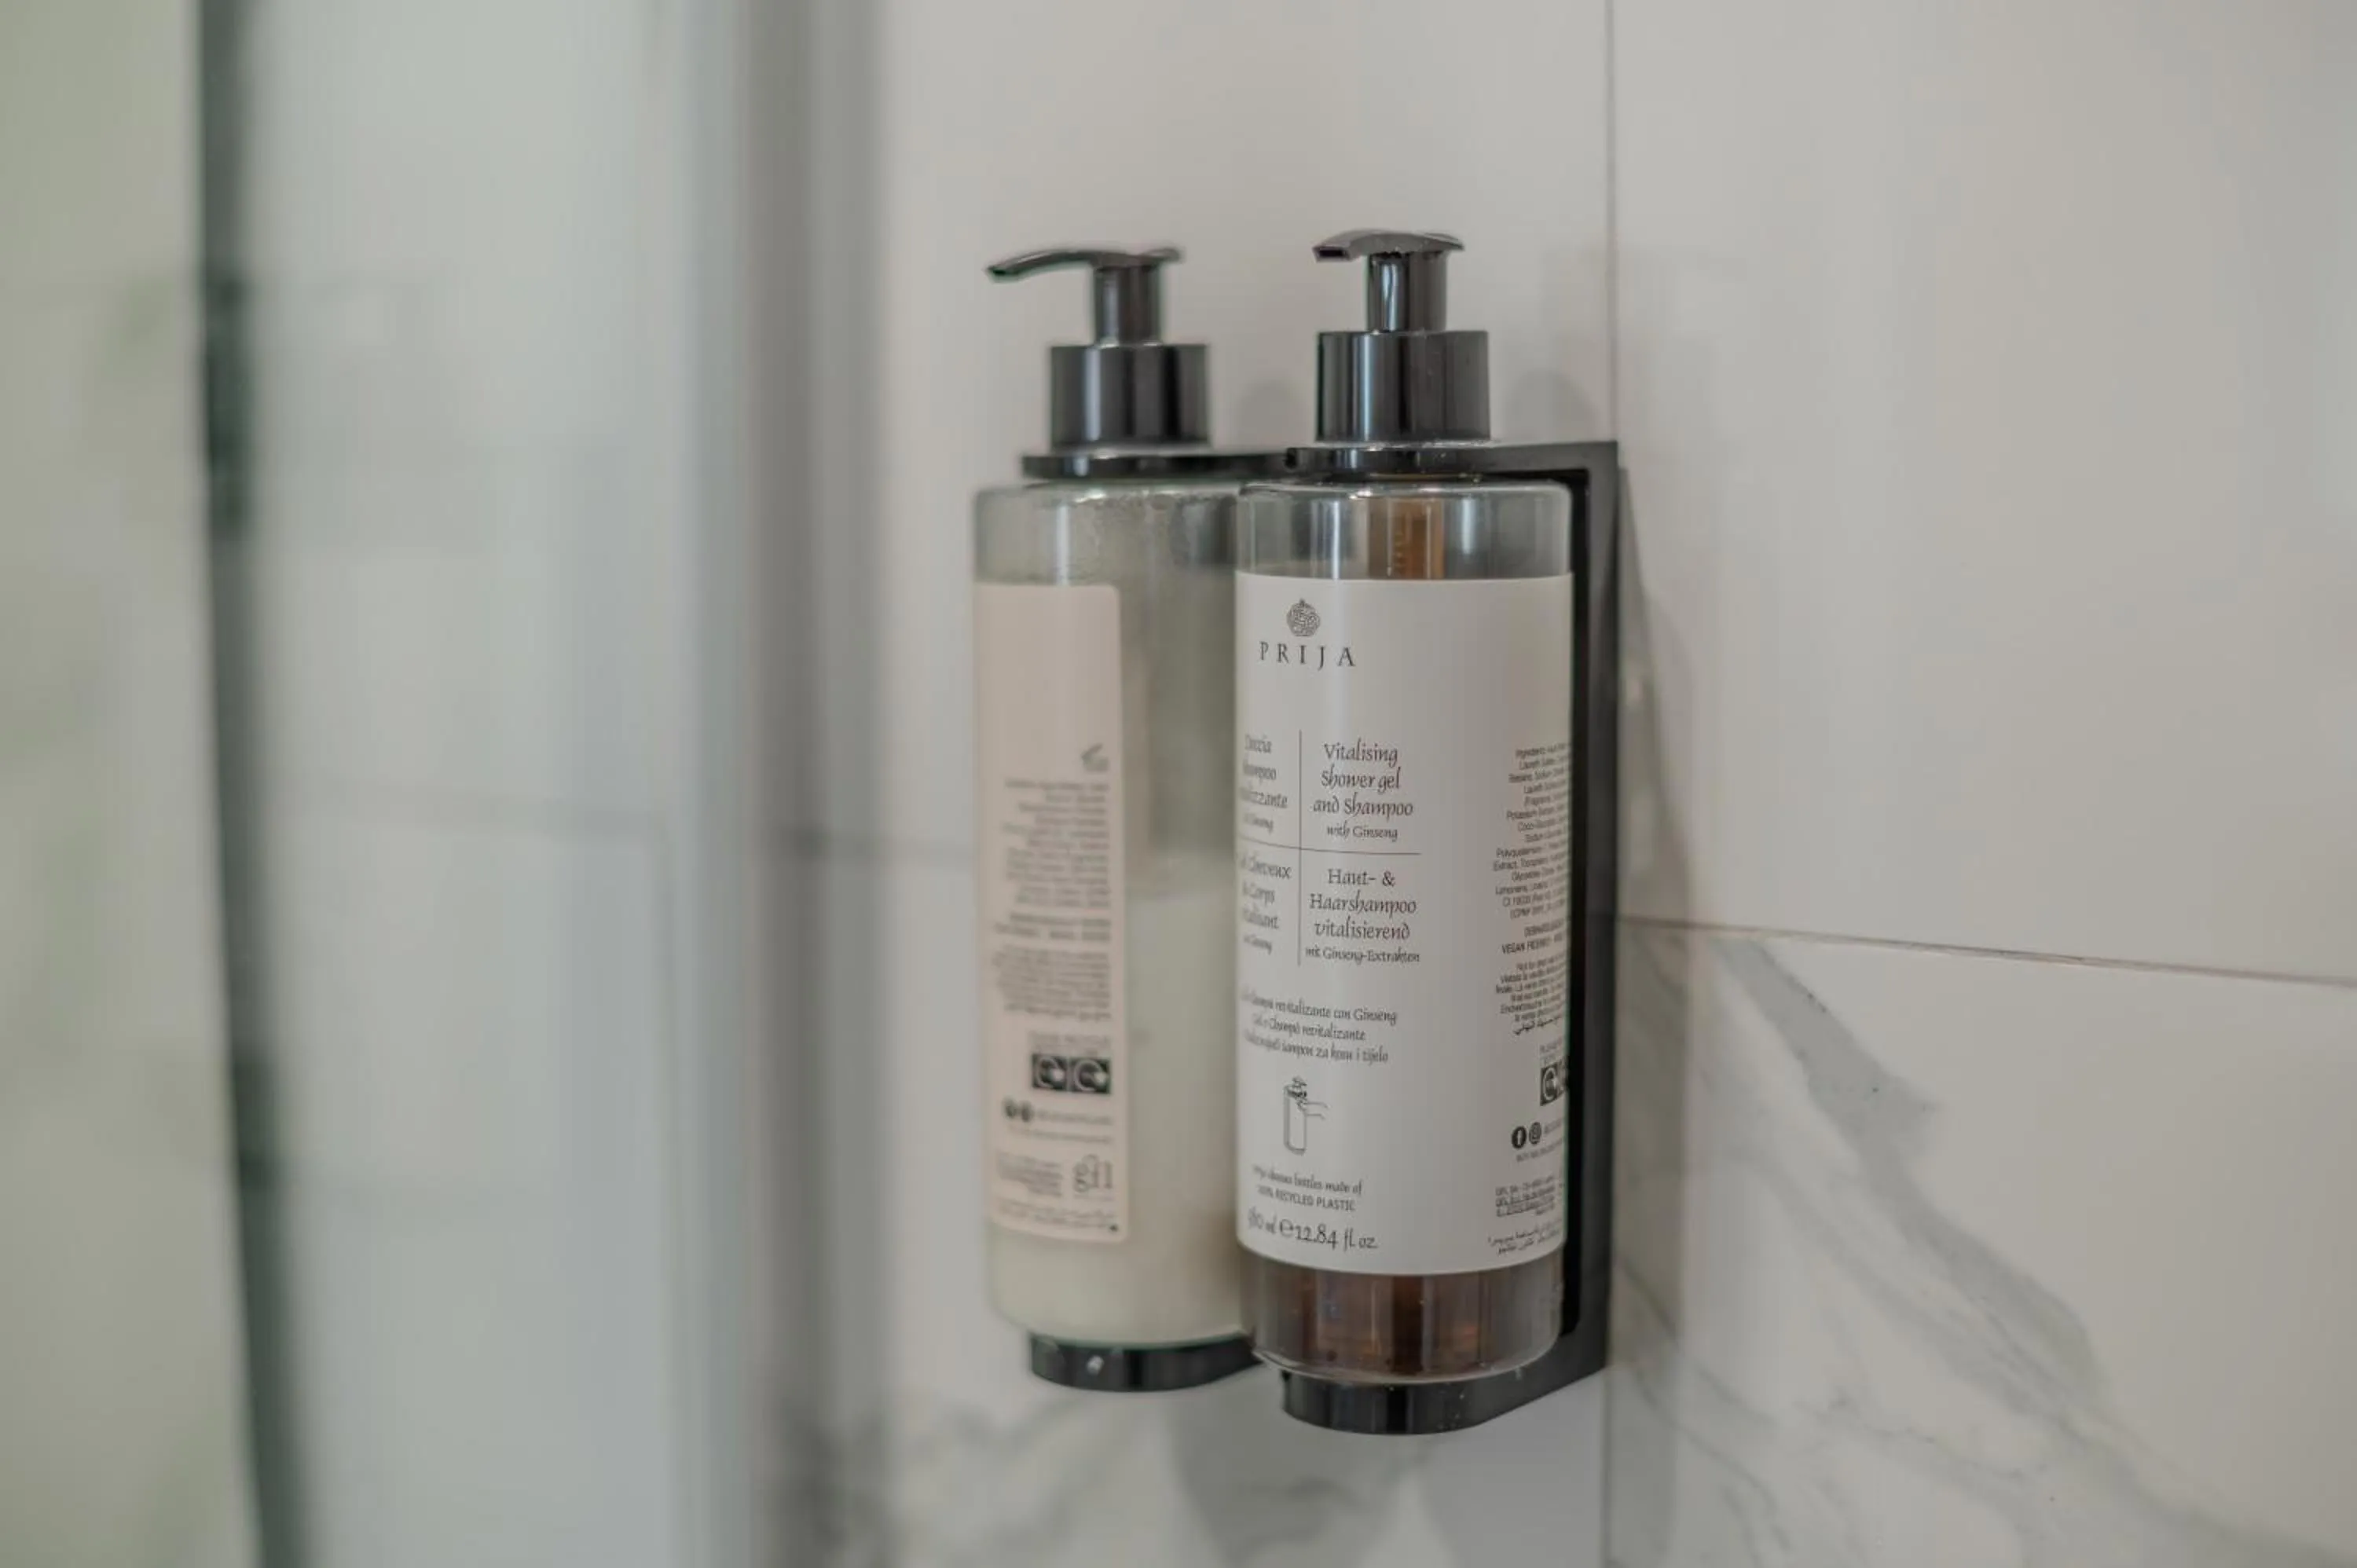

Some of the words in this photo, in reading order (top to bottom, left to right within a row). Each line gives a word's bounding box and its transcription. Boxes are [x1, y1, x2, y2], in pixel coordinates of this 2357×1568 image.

[1259, 641, 1356, 671] PRIJA
[1323, 738, 1398, 768] Vitalising
[1321, 764, 1375, 789] Shower
[1376, 766, 1402, 793] gel
[1313, 795, 1340, 813] and
[1343, 791, 1414, 822] Shampoo
[1326, 824, 1351, 840] with
[1352, 825, 1398, 841] Ginseng
[1328, 868, 1376, 886] Haut-
[1382, 870, 1396, 887] &
[1309, 889, 1417, 919] Haarshampoo
[1314, 915, 1411, 940] vitalisierend
[1333, 1009, 1351, 1020] con
[1353, 1008, 1398, 1026] Ginseng
[1302, 1020, 1366, 1041] revitalizante
[1316, 1046, 1329, 1058] za
[1325, 1181, 1351, 1193] made
[1352, 1178, 1362, 1196] of
[1275, 1188, 1314, 1207] RECYCLED
[1316, 1196, 1356, 1211] PLASTIC
